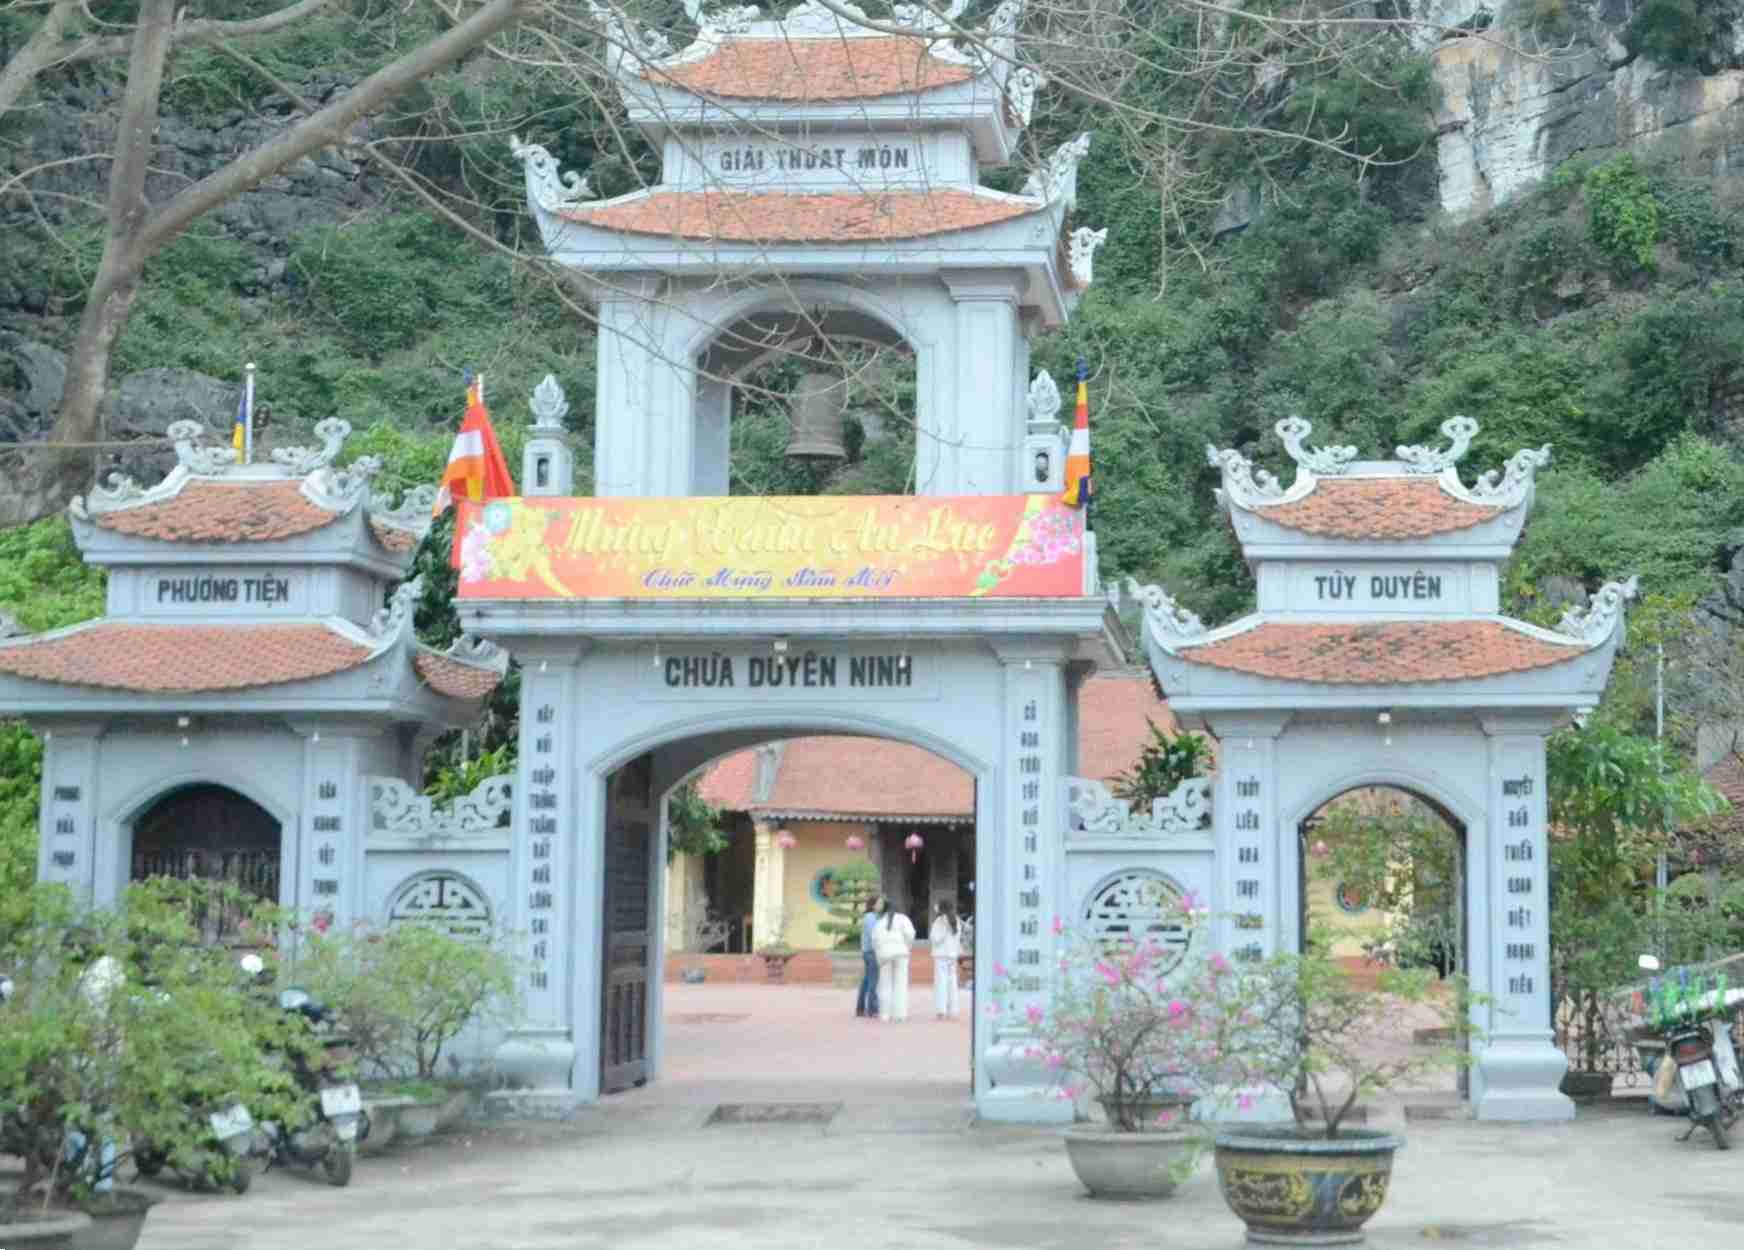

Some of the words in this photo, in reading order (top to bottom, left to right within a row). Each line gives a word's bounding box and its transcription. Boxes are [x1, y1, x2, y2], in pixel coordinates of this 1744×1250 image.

[157, 574, 239, 603] PHƯƠNG
[243, 571, 290, 609] TIỆN
[1370, 568, 1442, 600] DUYÊN
[664, 651, 735, 688] CHÙA
[748, 651, 837, 688] DUYÊN
[850, 656, 913, 688] NINH
